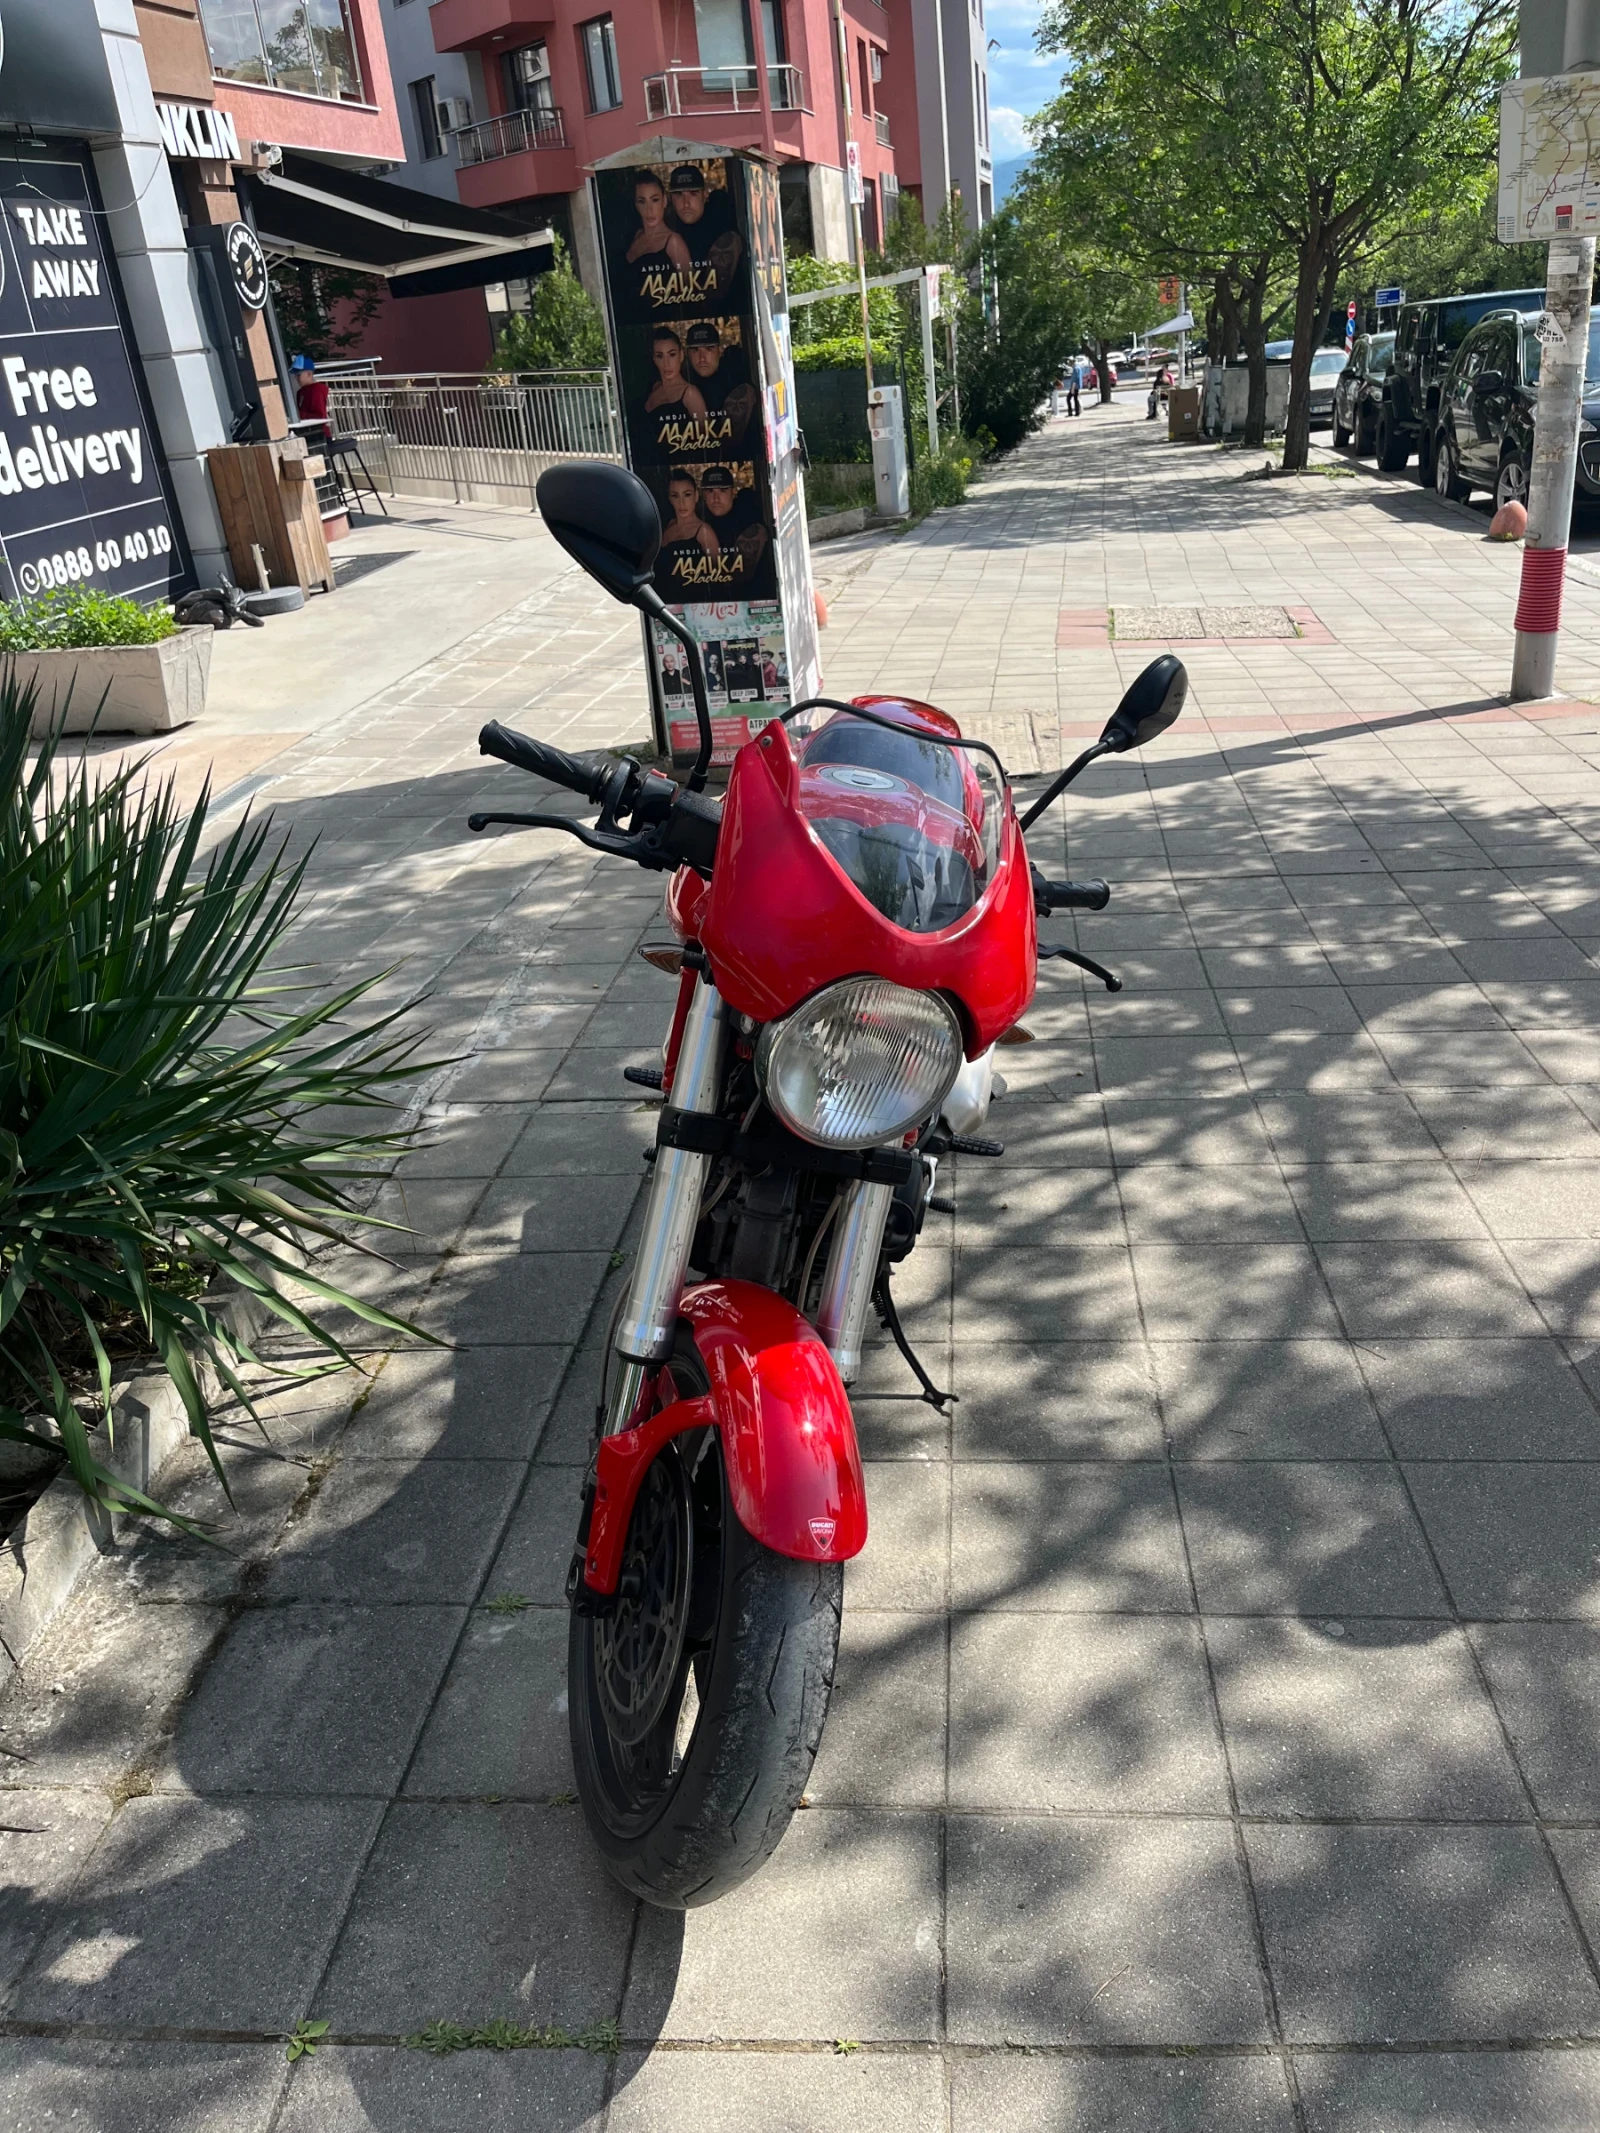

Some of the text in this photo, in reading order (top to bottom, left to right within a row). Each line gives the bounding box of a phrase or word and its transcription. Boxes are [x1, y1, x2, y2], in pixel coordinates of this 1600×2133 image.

[16, 207, 88, 246] TAKE
[641, 264, 670, 273] ANDJI
[689, 260, 712, 268] TONI
[33, 260, 101, 299] AWAY
[639, 268, 718, 296] MALKA
[651, 285, 706, 308] Sladka
[2, 356, 98, 417] Free
[704, 410, 727, 418] TONI
[657, 418, 732, 443] MALKA
[669, 433, 721, 454] Sladka
[0, 425, 143, 495] delivery
[37, 524, 172, 589] 0888 60 40 10
[670, 554, 744, 576] MALKA
[681, 568, 733, 587] Sladka
